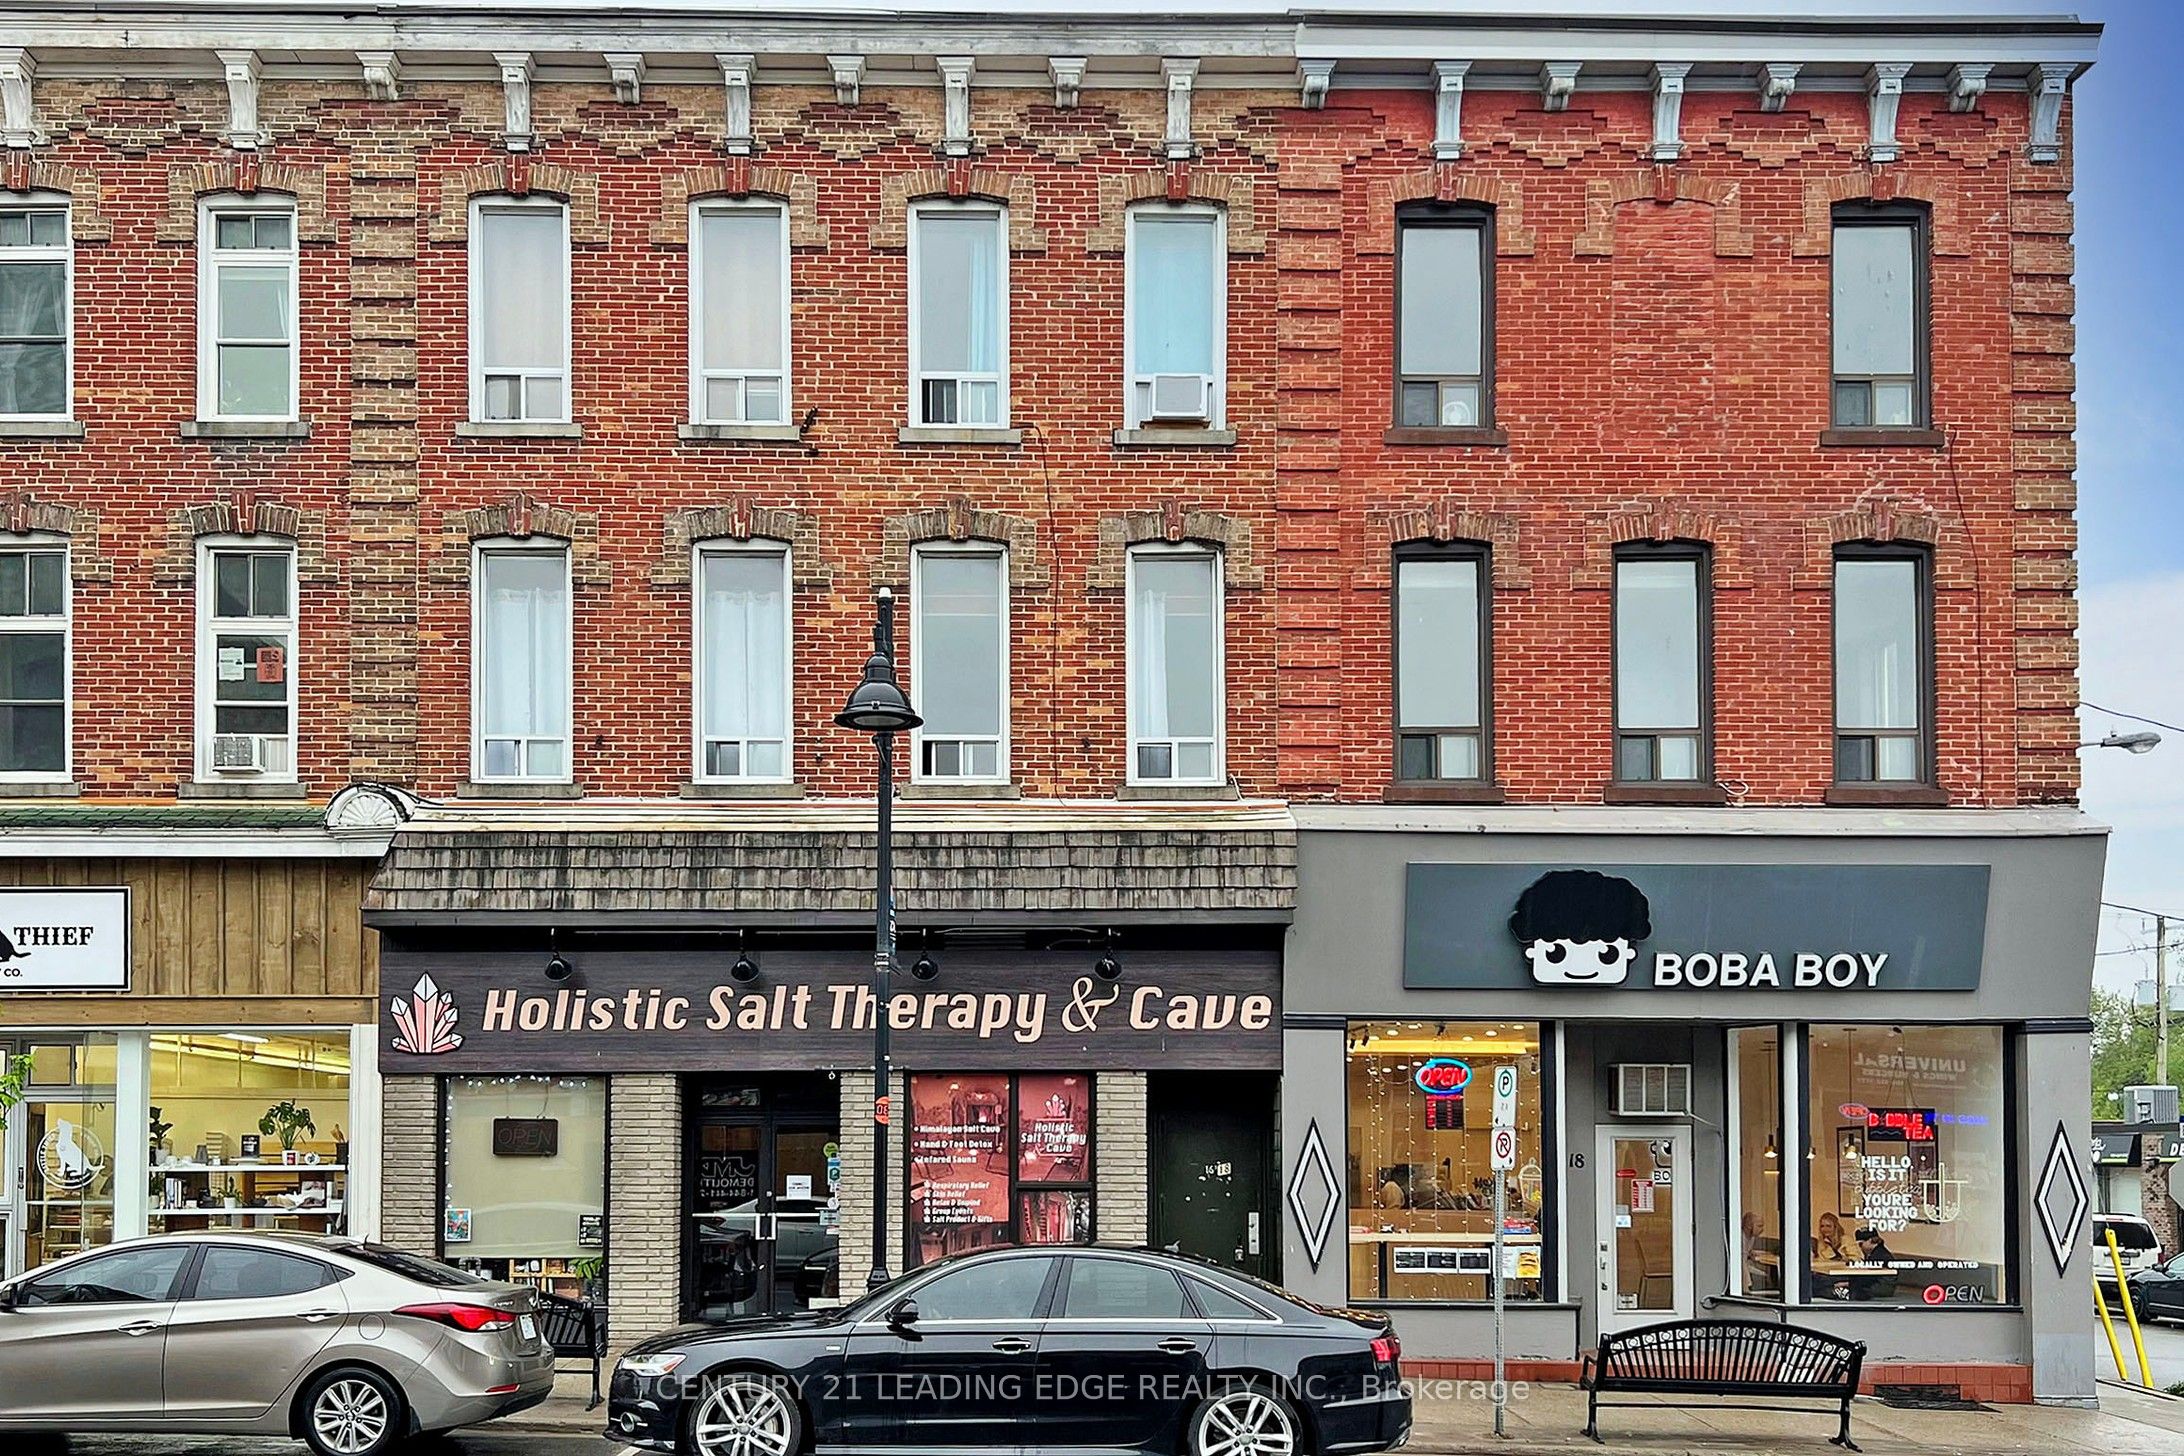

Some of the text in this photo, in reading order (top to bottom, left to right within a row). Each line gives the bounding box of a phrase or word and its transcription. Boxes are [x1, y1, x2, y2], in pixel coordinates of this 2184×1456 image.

[13, 926, 94, 946] THIEF
[3, 968, 23, 977] CO.
[1654, 952, 1889, 988] BOBA BOY
[482, 976, 1273, 1043] Holistic Salt Therapy & Cave
[1419, 1066, 1468, 1087] OPEN
[1502, 1076, 1510, 1091] P
[1034, 1122, 1075, 1133] Holistic
[1903, 1125, 1934, 1141] TEA
[499, 1127, 554, 1146] OPEN
[1020, 1132, 1087, 1145] Salt Therapy
[1046, 1143, 1073, 1153] Cave
[1569, 1153, 1585, 1168] 18
[1868, 1168, 1907, 1181] IS IT
[1863, 1193, 1913, 1207] YOURE
[1855, 1206, 1919, 1219] LOOKING
[1868, 1219, 1907, 1232] FOR?
[1848, 1260, 1885, 1269] LOCALLY
[1917, 1260, 1934, 1269] AND
[1937, 1260, 1979, 1269] OPERATED
[1922, 1284, 1984, 1305] OPEN
